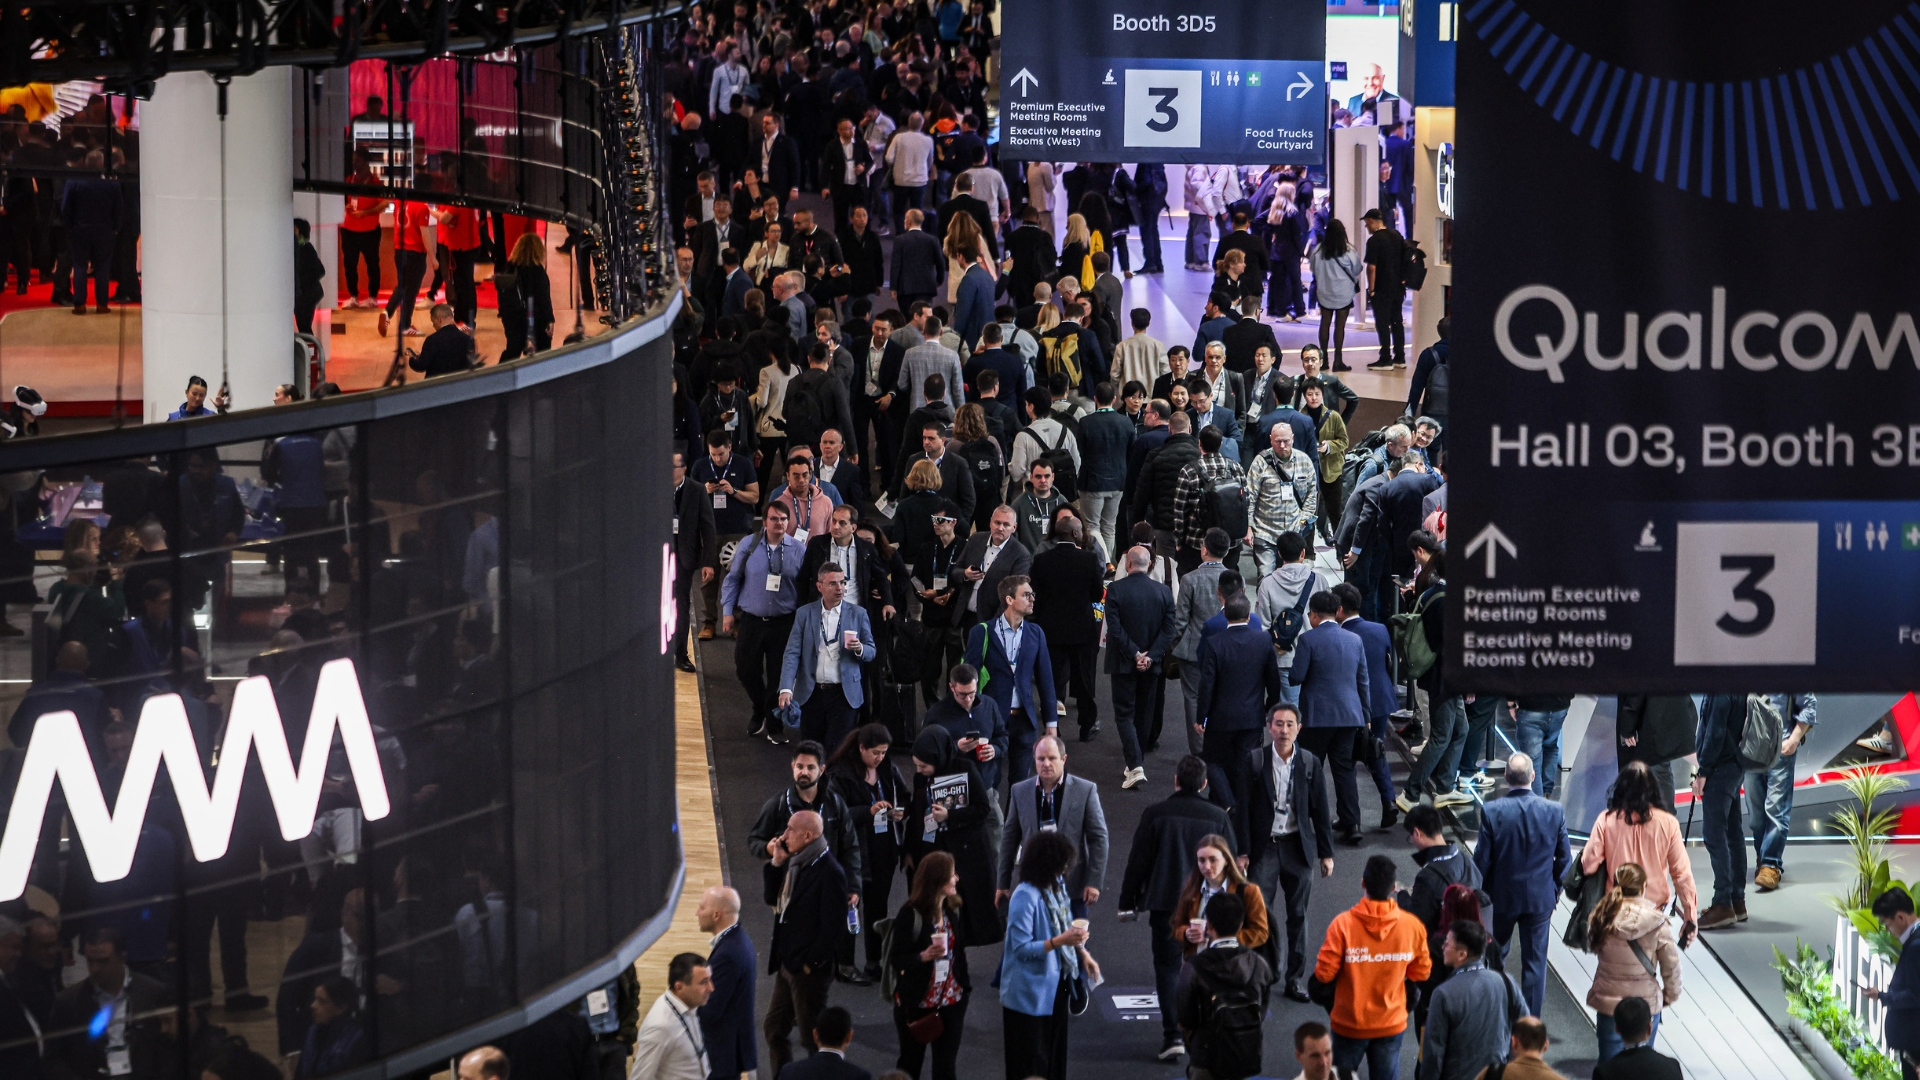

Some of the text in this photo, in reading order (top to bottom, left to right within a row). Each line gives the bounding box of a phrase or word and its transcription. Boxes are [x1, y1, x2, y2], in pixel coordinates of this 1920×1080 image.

[1112, 13, 1216, 33] Booth 3D5
[1010, 102, 1106, 112] Premium Executive
[1145, 87, 1179, 133] 3
[1010, 112, 1088, 123] Meeting Rooms
[1010, 127, 1101, 138] Executive Meeting
[1245, 128, 1314, 139] Food Trucks
[1010, 137, 1081, 147] Rooms (West)
[1257, 139, 1313, 151] Courtyard
[1491, 423, 1590, 467] Hall
[1605, 424, 1686, 474] 03,
[1702, 424, 1854, 467] Booth
[1464, 586, 1641, 604] Premium Executive
[1715, 553, 1776, 638] 3
[1464, 605, 1607, 624] Meeting Rooms
[1463, 632, 1632, 651] Executive Meeting
[1463, 650, 1595, 669] Rooms (West)
[1345, 952, 1413, 963] EXPLORERS
